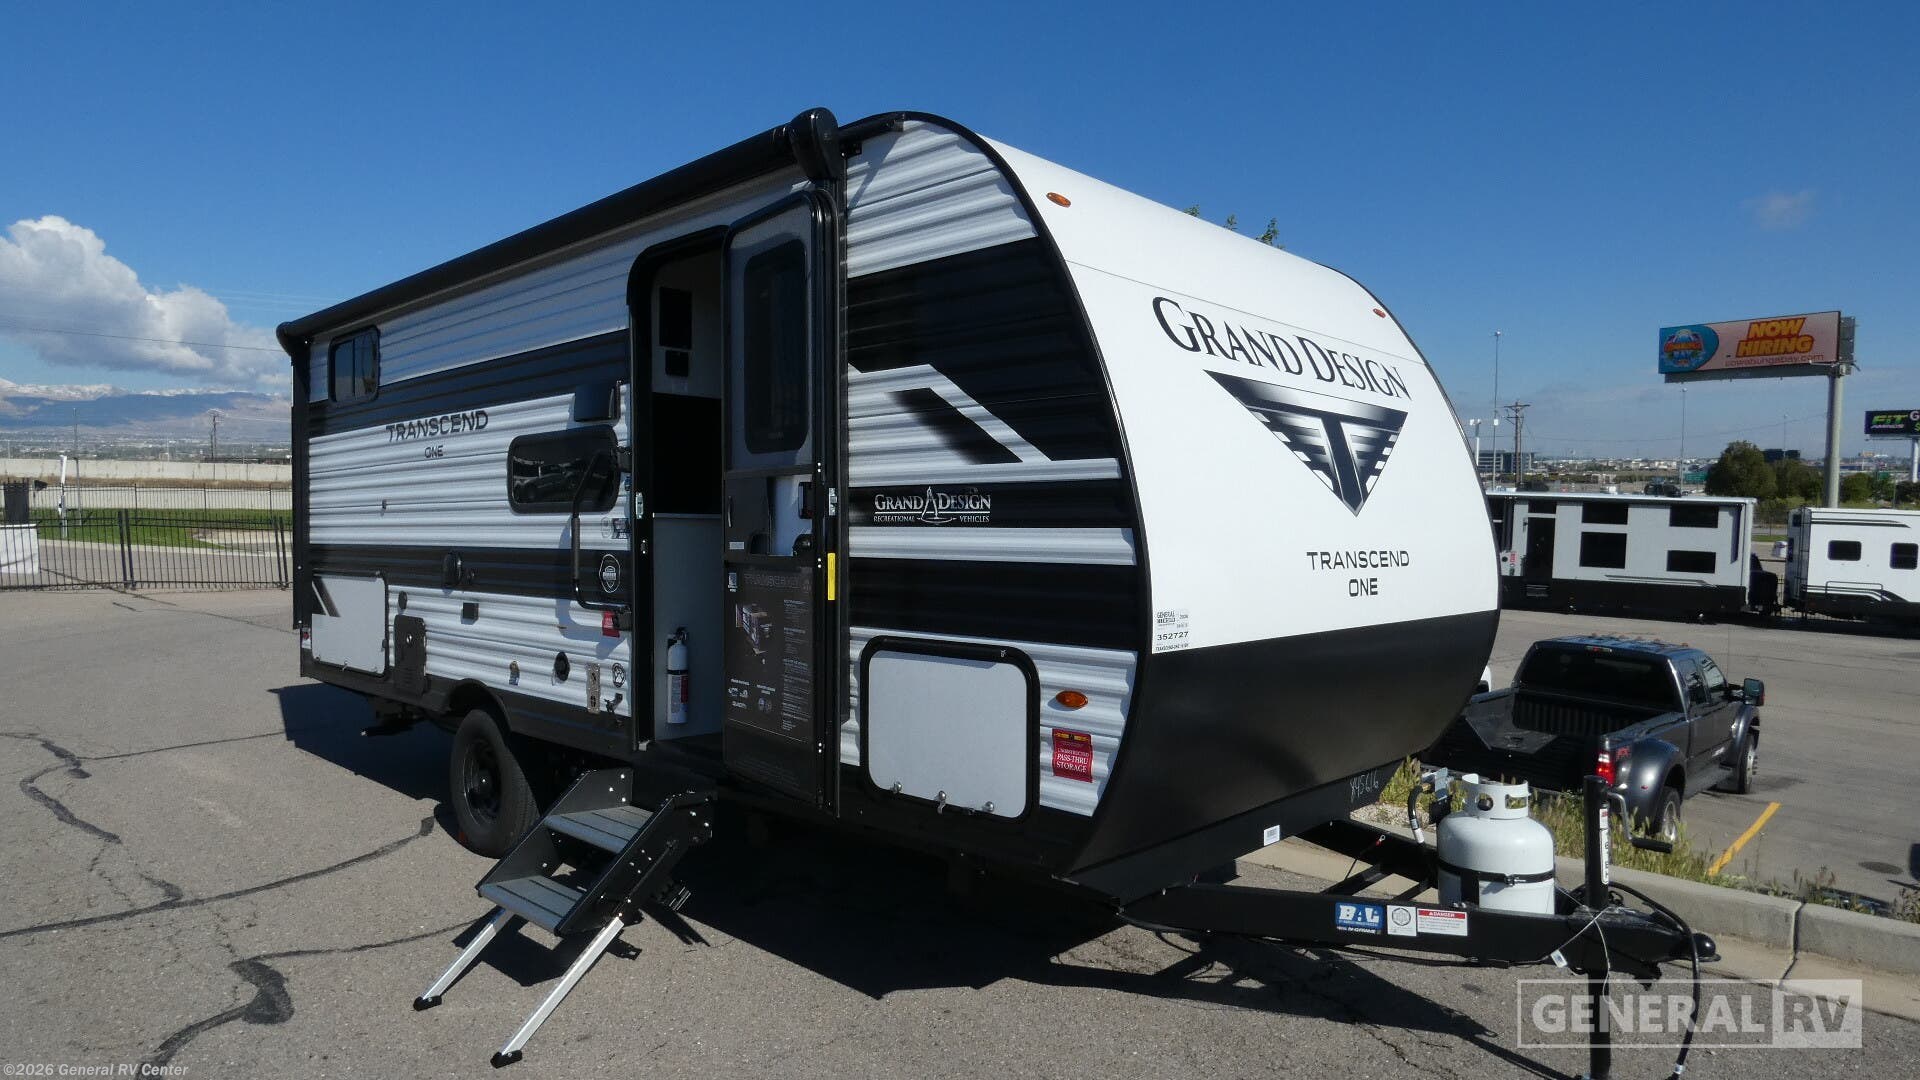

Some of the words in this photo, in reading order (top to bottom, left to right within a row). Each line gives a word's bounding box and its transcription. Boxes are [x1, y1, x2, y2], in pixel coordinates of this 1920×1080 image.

[1747, 317, 1806, 339] NOW
[1152, 297, 1303, 376] GRAND
[1293, 334, 1412, 400] DESIGN
[1736, 335, 1814, 357] HIRING
[385, 410, 489, 442] TRANSCEND
[424, 445, 444, 459] ONE
[874, 494, 924, 510] GRAND
[936, 492, 991, 510] DESIGN
[959, 515, 990, 523] VEHICLES
[1306, 551, 1410, 570] TRANSCEND
[1349, 578, 1378, 597] ONE
[1157, 631, 1189, 641] 352727
[1056, 760, 1087, 772] STORAGE
[1057, 753, 1089, 765] PASS-THRU
